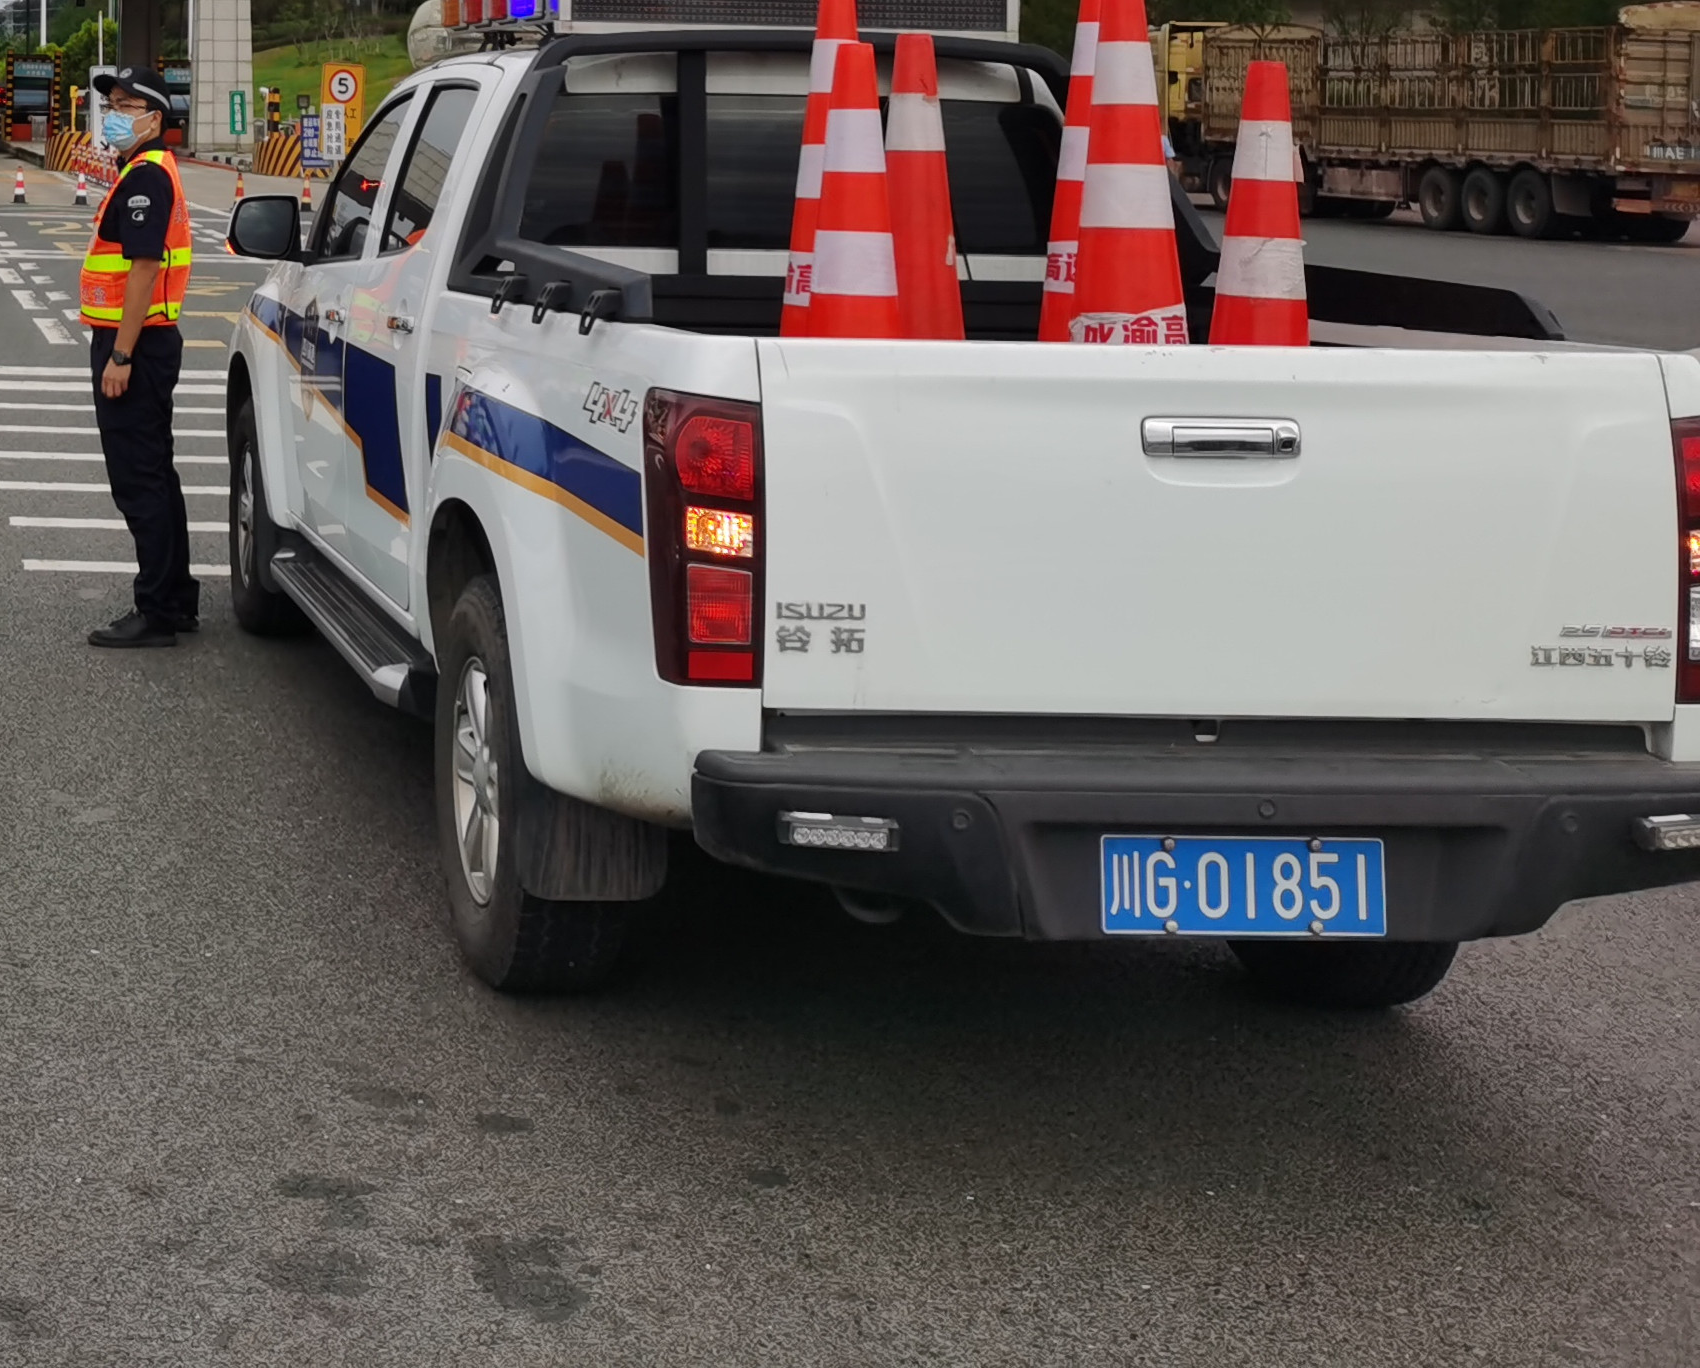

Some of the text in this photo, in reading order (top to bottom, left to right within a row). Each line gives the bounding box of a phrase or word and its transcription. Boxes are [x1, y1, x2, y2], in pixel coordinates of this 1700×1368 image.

[337, 77, 349, 94] 5
[775, 601, 867, 621] ISUZU
[1530, 645, 1672, 669] 江西五十铃
[1109, 850, 1368, 921] 川G·01851
